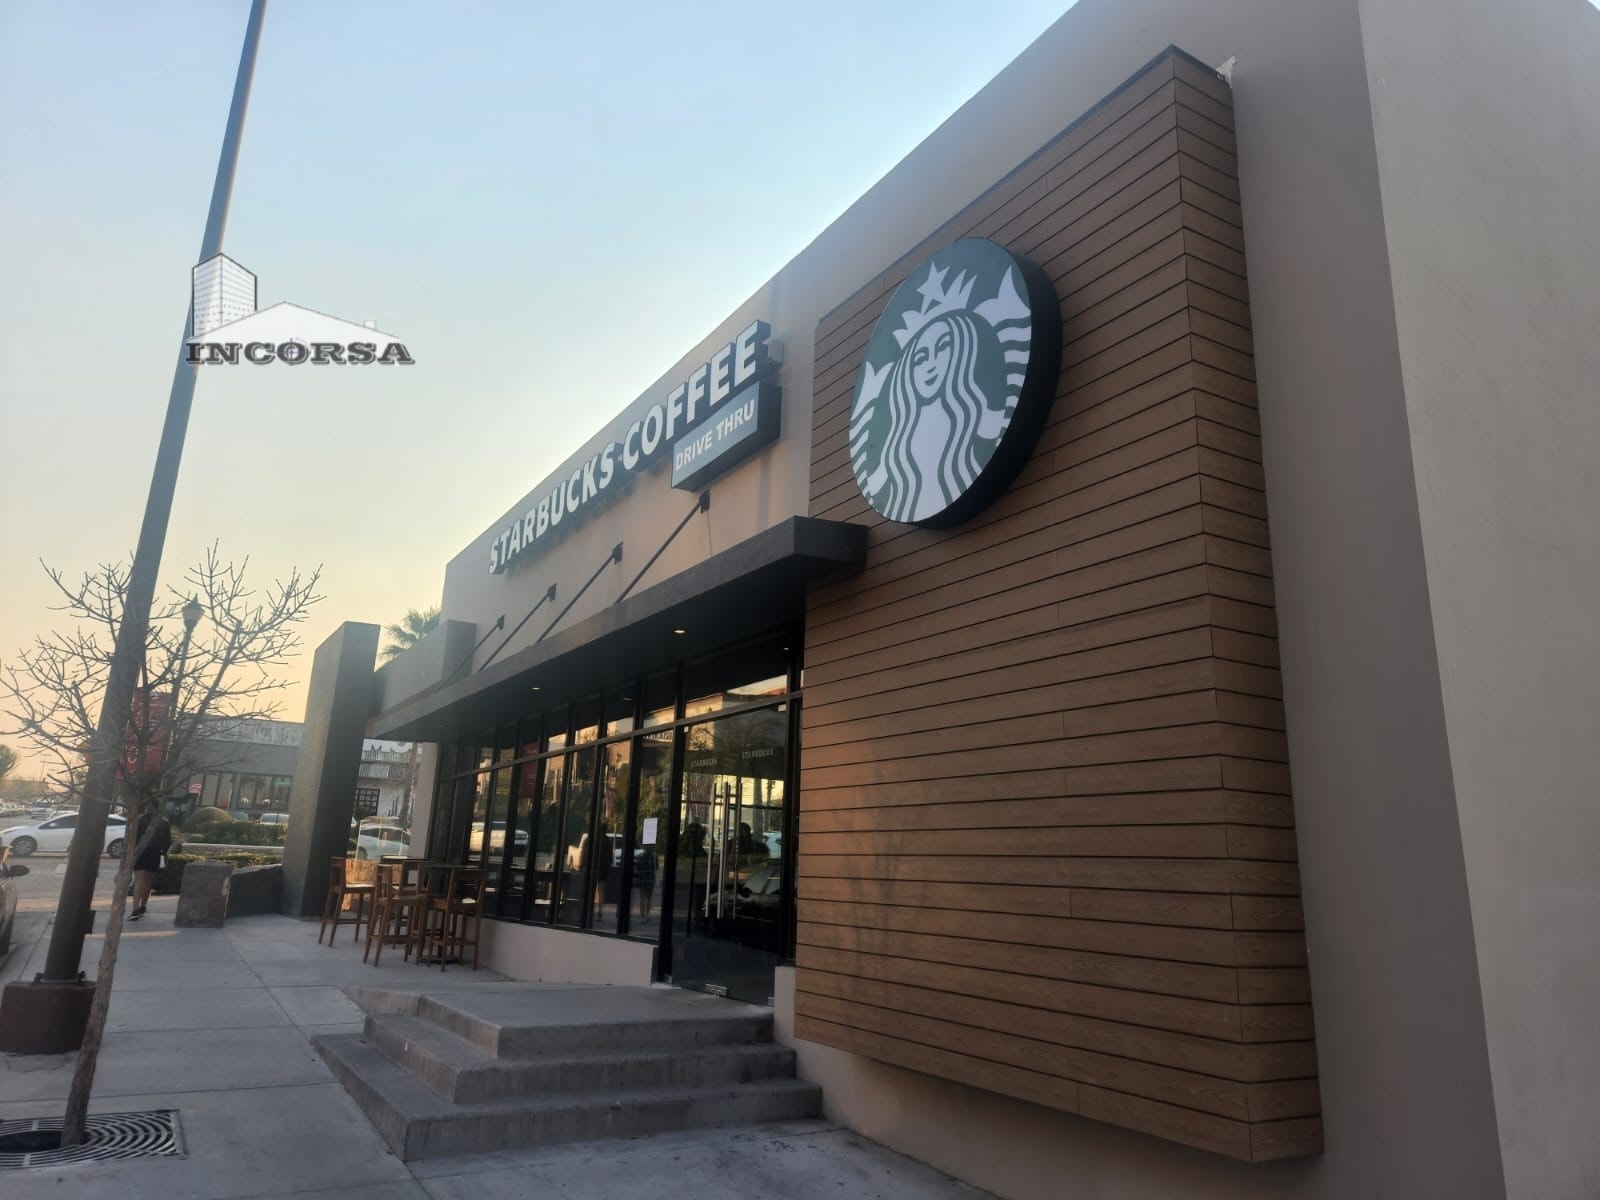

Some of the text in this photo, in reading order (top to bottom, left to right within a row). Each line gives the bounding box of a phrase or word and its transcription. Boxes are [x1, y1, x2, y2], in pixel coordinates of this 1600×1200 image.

[488, 320, 759, 574] STARBUCKS COFFEE
[675, 399, 755, 471] DRIVE THRU
